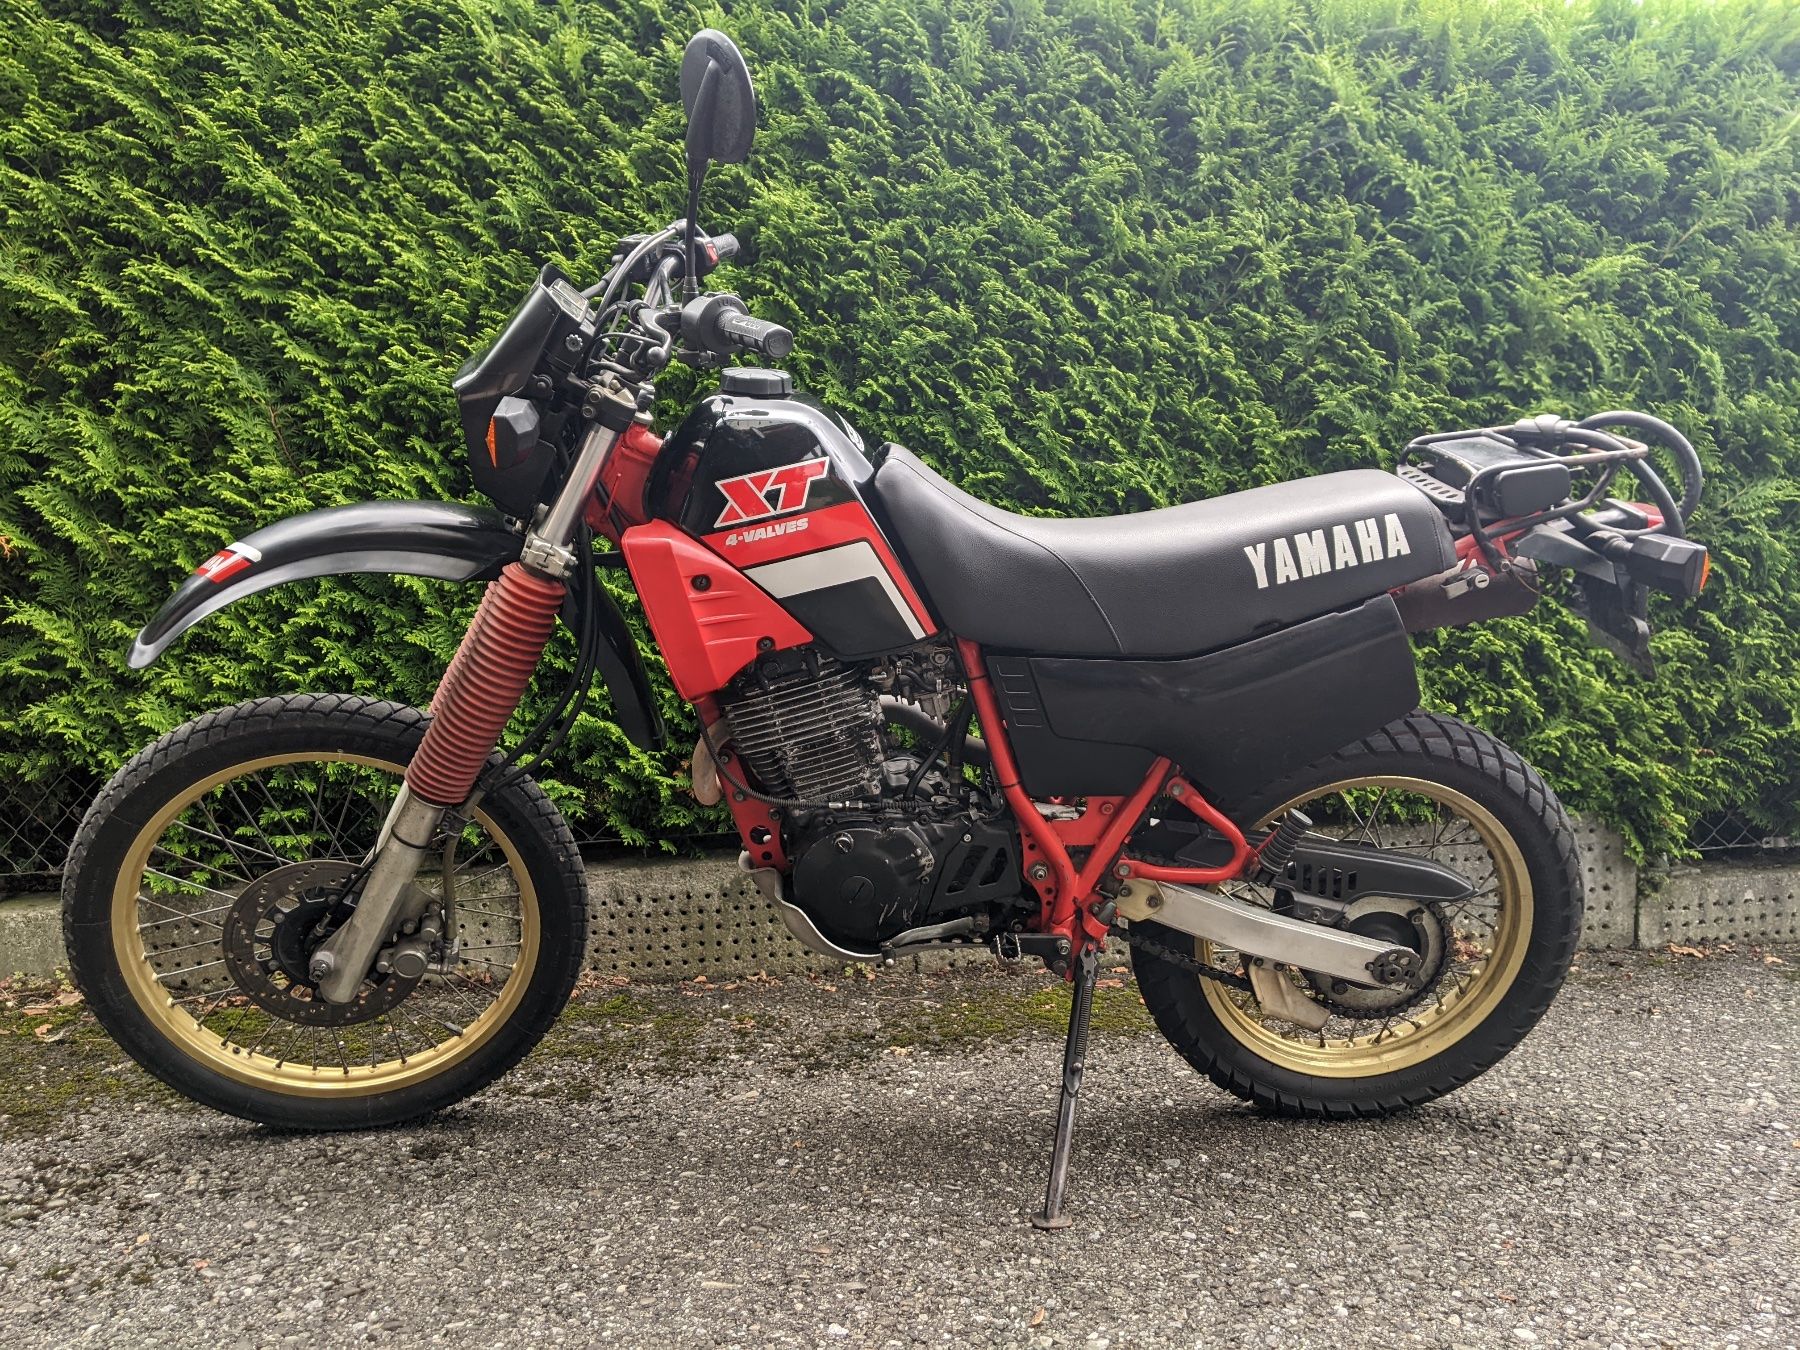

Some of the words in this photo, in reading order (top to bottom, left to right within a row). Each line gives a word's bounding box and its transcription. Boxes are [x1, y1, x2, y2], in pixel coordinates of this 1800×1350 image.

[714, 457, 830, 528] XT
[725, 518, 809, 546] 4-VALVES
[1243, 512, 1411, 589] YAMAHA
